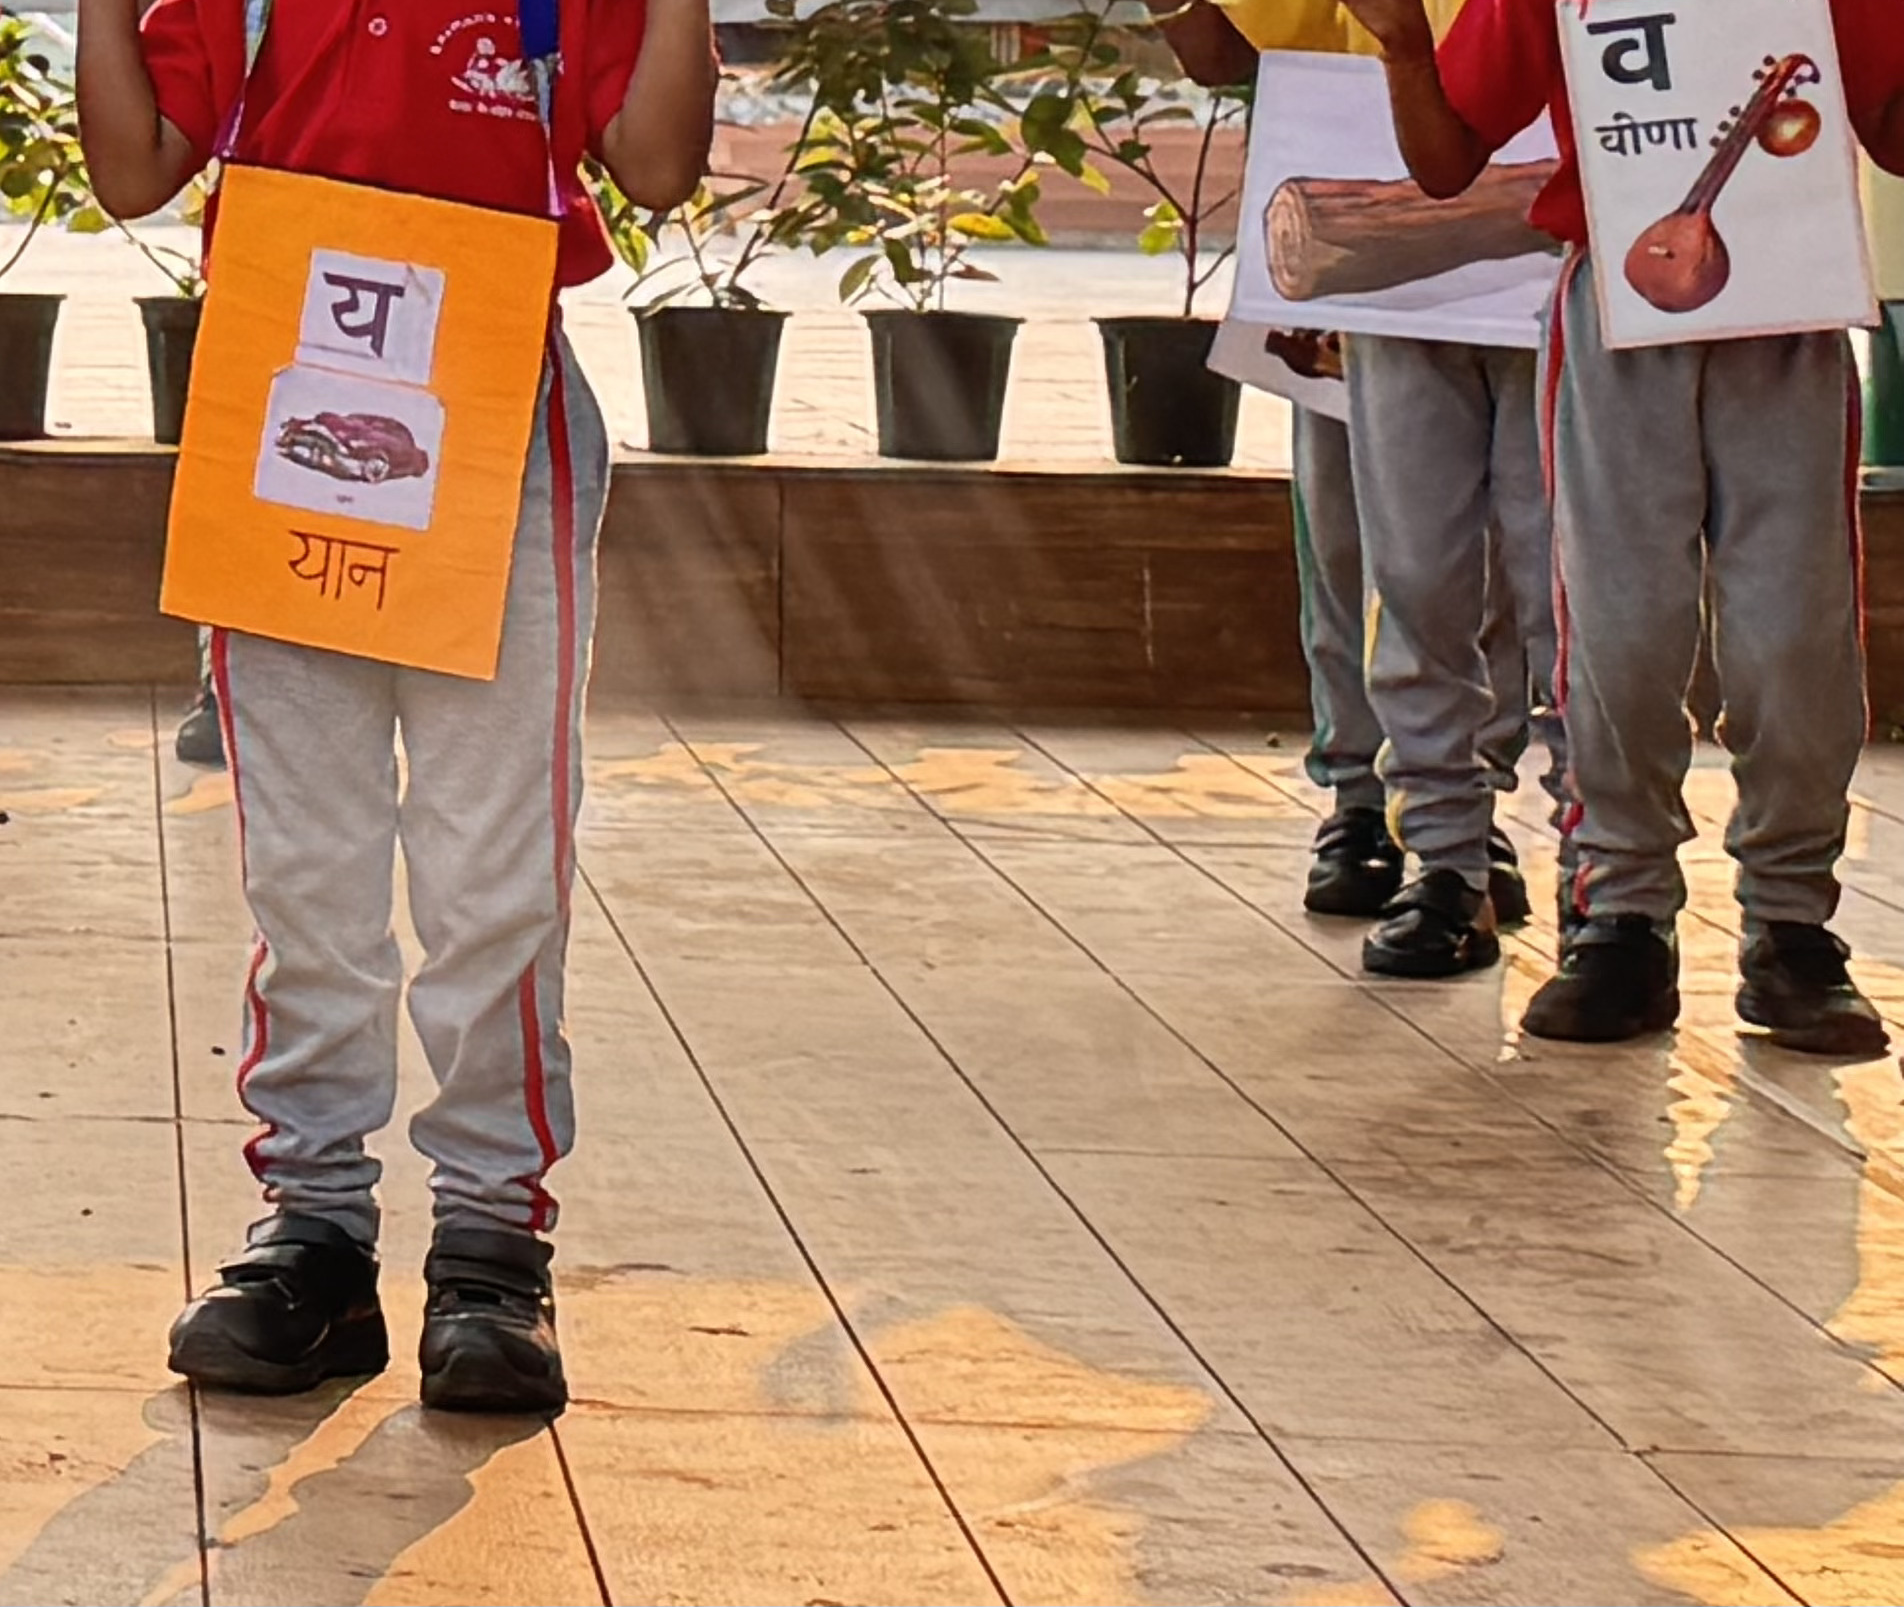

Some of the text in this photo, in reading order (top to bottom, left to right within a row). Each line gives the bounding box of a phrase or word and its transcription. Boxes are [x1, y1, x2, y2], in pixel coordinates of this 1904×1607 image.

[1586, 12, 1676, 91] व
[323, 273, 405, 358] य
[288, 528, 400, 611] यान
